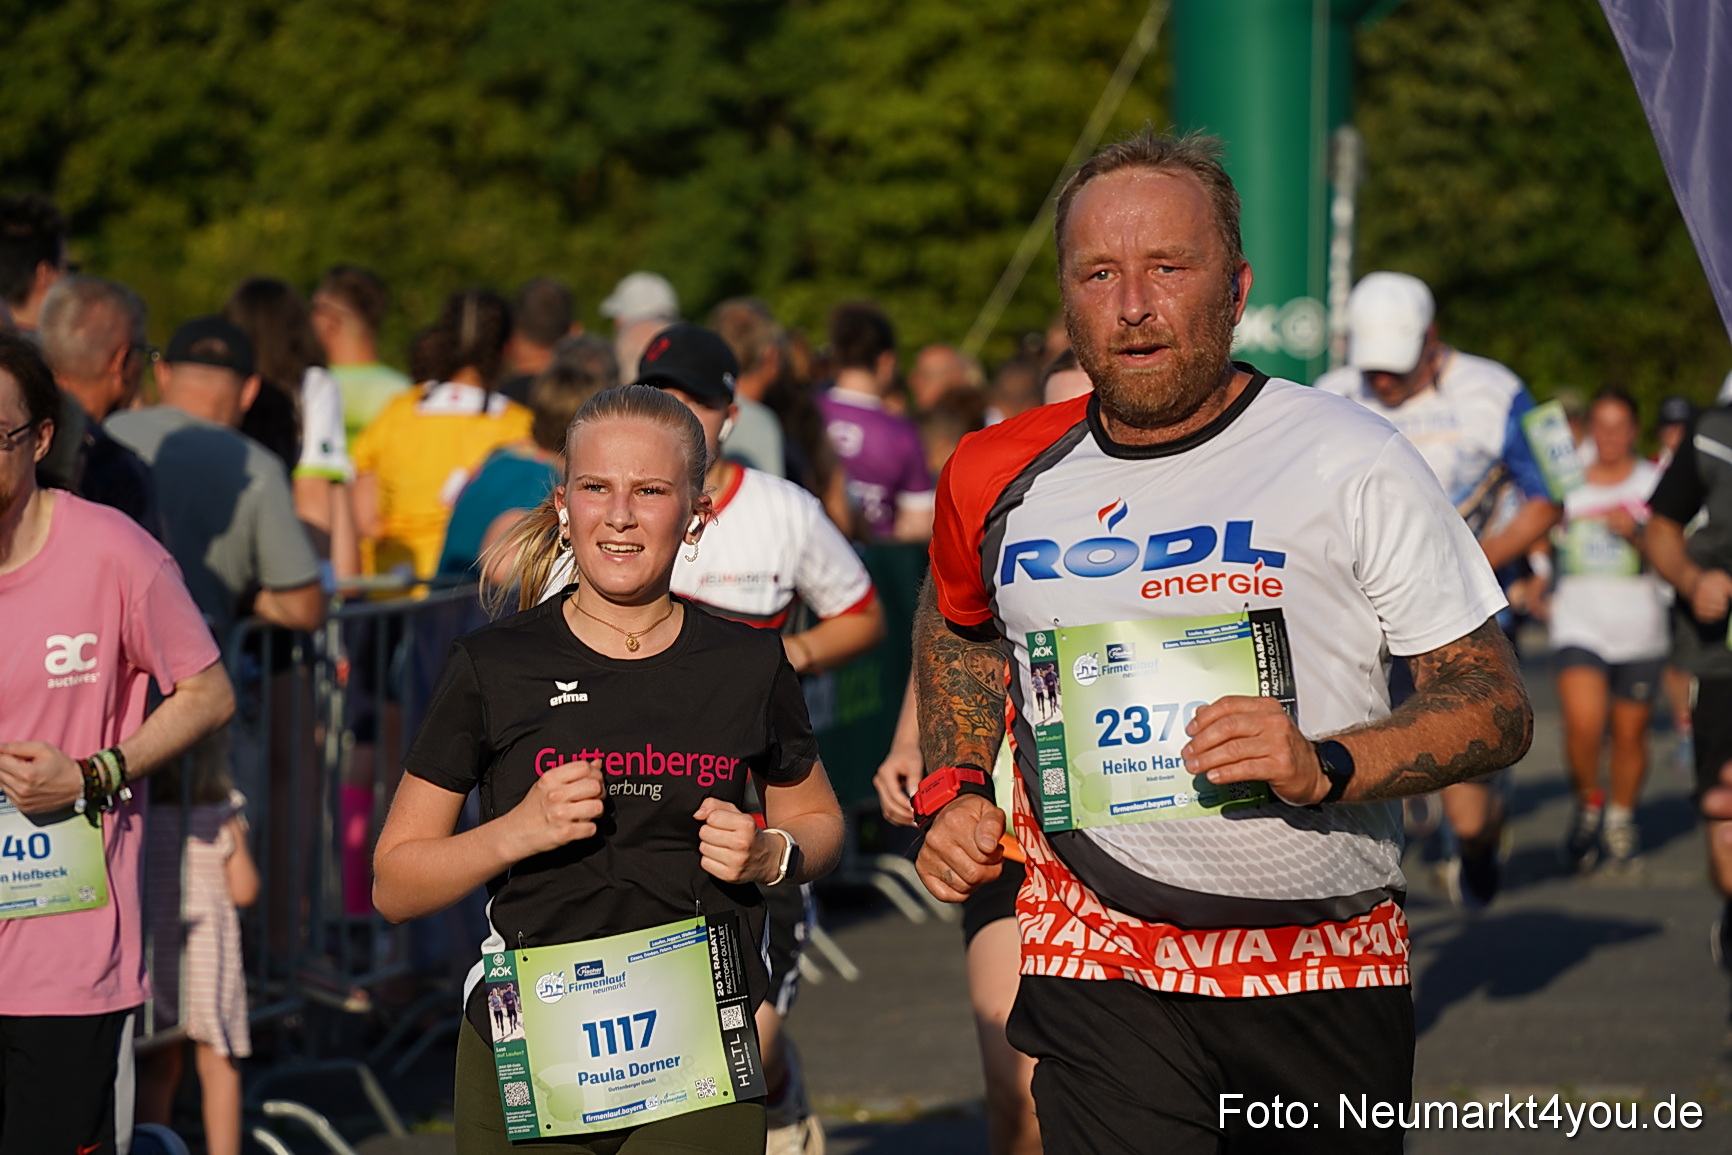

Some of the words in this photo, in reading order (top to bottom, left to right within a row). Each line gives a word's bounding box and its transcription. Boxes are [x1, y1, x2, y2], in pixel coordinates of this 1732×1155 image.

[1141, 557, 1283, 599] energie
[1032, 646, 1053, 658] AOK
[1252, 622, 1267, 669] RABATT
[1263, 622, 1276, 656] OUTLET
[1269, 657, 1279, 696] FACTORY
[550, 692, 588, 707] erima
[535, 744, 740, 787] Guttenberger
[1103, 759, 1147, 775] Heiko
[1152, 754, 1188, 770] Har
[606, 779, 664, 801] erbung
[12, 866, 69, 882] Hofbeck
[708, 926, 721, 970] RABATT
[718, 925, 728, 957] OUTLET
[1154, 929, 1278, 971] AVIA
[489, 965, 513, 978] AOK
[568, 971, 627, 993] Firmenlauf
[715, 970, 722, 979] %
[721, 958, 733, 994] FACTORY
[592, 981, 627, 995] neumarkt
[716, 982, 724, 997] 20
[582, 1010, 657, 1058] 1117
[578, 1067, 625, 1086] Paula
[629, 1056, 681, 1077] Dorner
[730, 1033, 750, 1087] HILTL
[586, 1103, 644, 1122] firmenlauf.bayern
